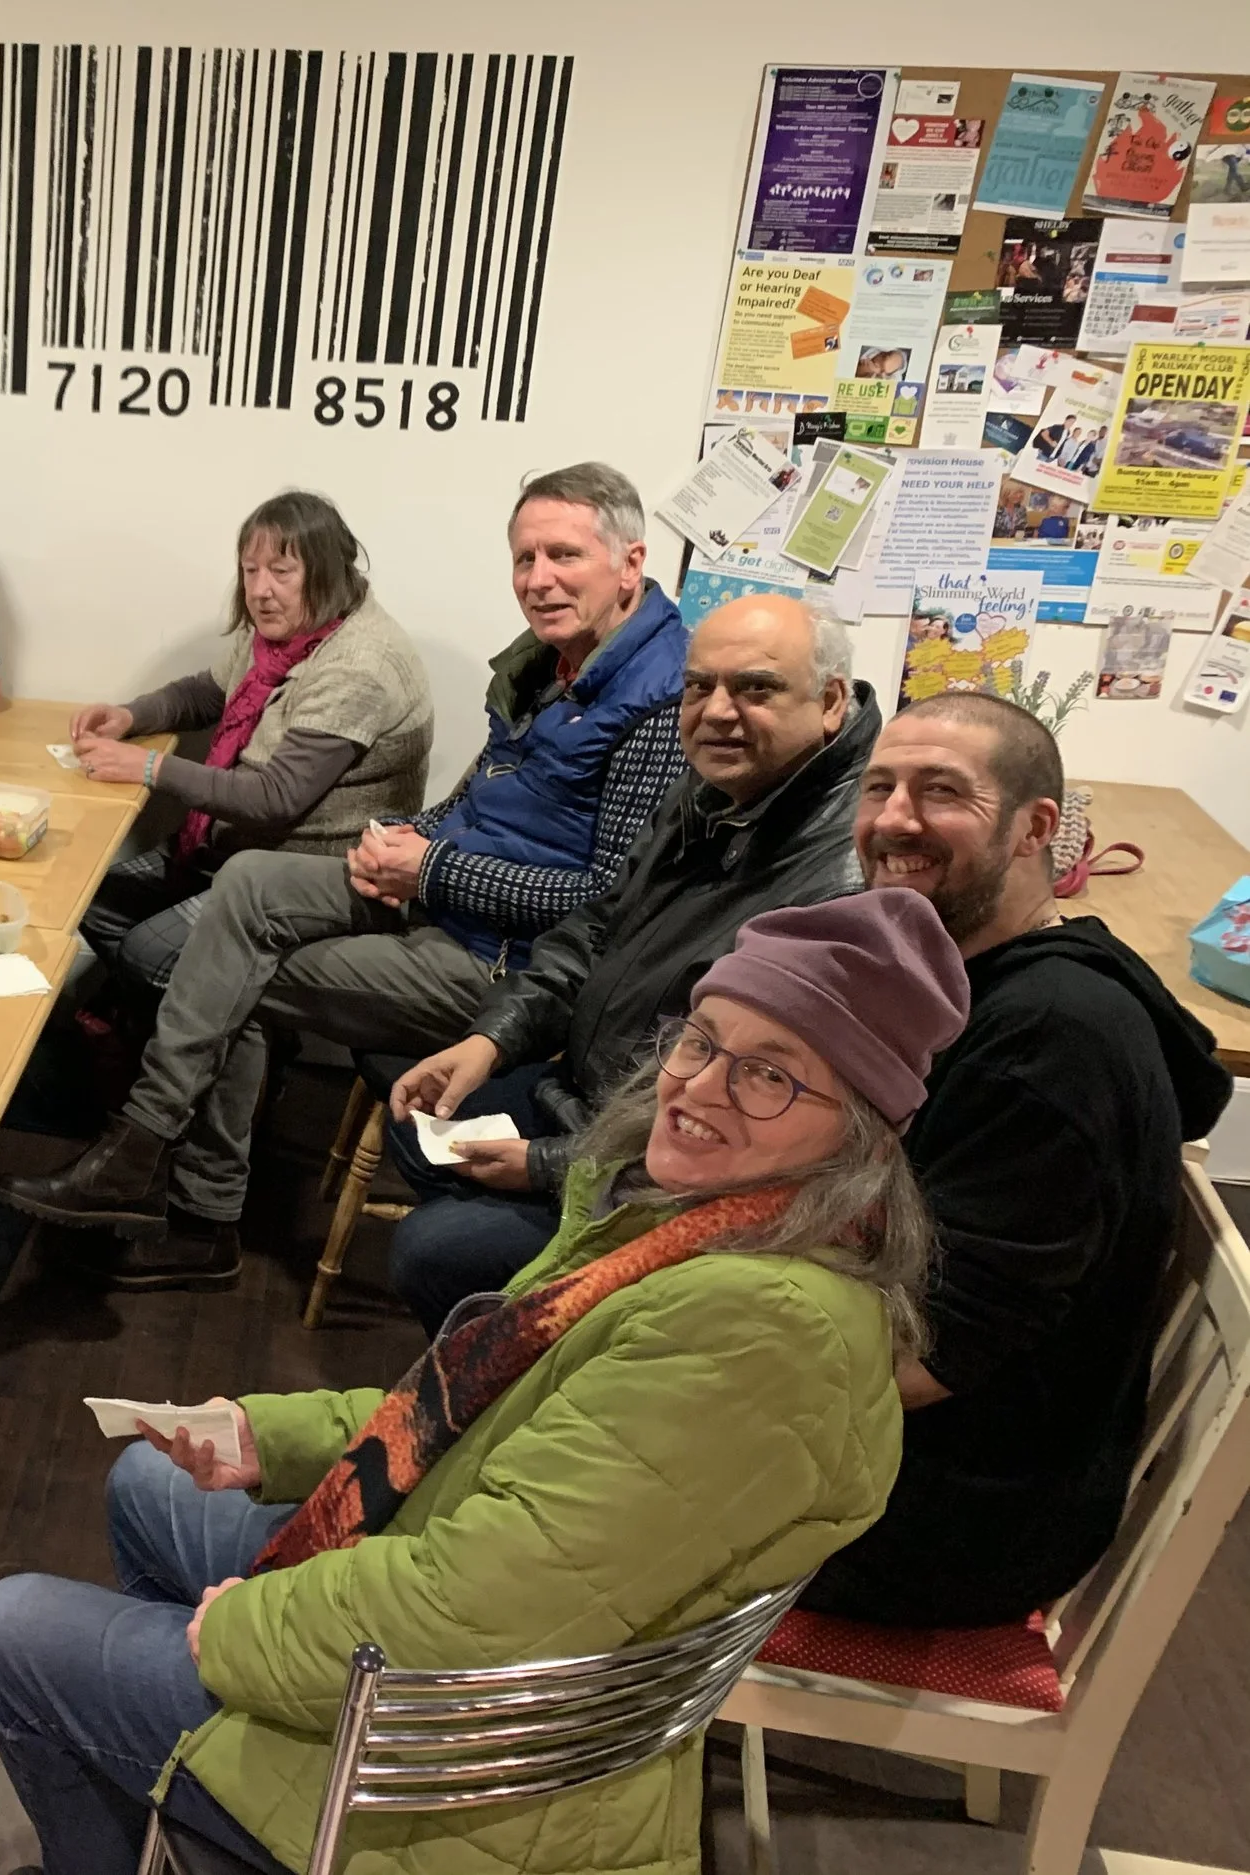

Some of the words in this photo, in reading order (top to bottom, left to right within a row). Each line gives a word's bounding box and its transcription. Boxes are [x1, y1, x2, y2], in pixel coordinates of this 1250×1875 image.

[742, 266, 764, 278] Are
[767, 269, 790, 280] you
[793, 269, 822, 281] Deaf
[740, 283, 753, 292] or
[756, 283, 802, 297] Hearing
[737, 296, 797, 309] Impaired?
[1013, 292, 1054, 303] Services
[1151, 352, 1197, 361] WARLEY
[1200, 354, 1239, 364] MODEL
[1151, 361, 1201, 371] RAILWAY
[1203, 363, 1235, 372] CLUB
[837, 383, 855, 396] RE
[858, 383, 890, 399] USE!
[1134, 372, 1191, 398] OPEN
[1191, 375, 1236, 400] DAY
[47, 360, 191, 417] 7120
[313, 376, 461, 432] 8518
[907, 458, 948, 466] rovision
[951, 458, 985, 467] House
[1116, 468, 1151, 478] Sunday
[1176, 471, 1219, 482] February
[901, 480, 930, 488] NEED
[933, 480, 964, 489] YOUR
[966, 481, 995, 489] HELP
[1168, 479, 1191, 488] 4pm
[764, 559, 798, 573] digital
[938, 573, 972, 589] that
[920, 585, 982, 601] Slimming
[987, 587, 1026, 600] World
[978, 595, 1035, 621] feeling!
